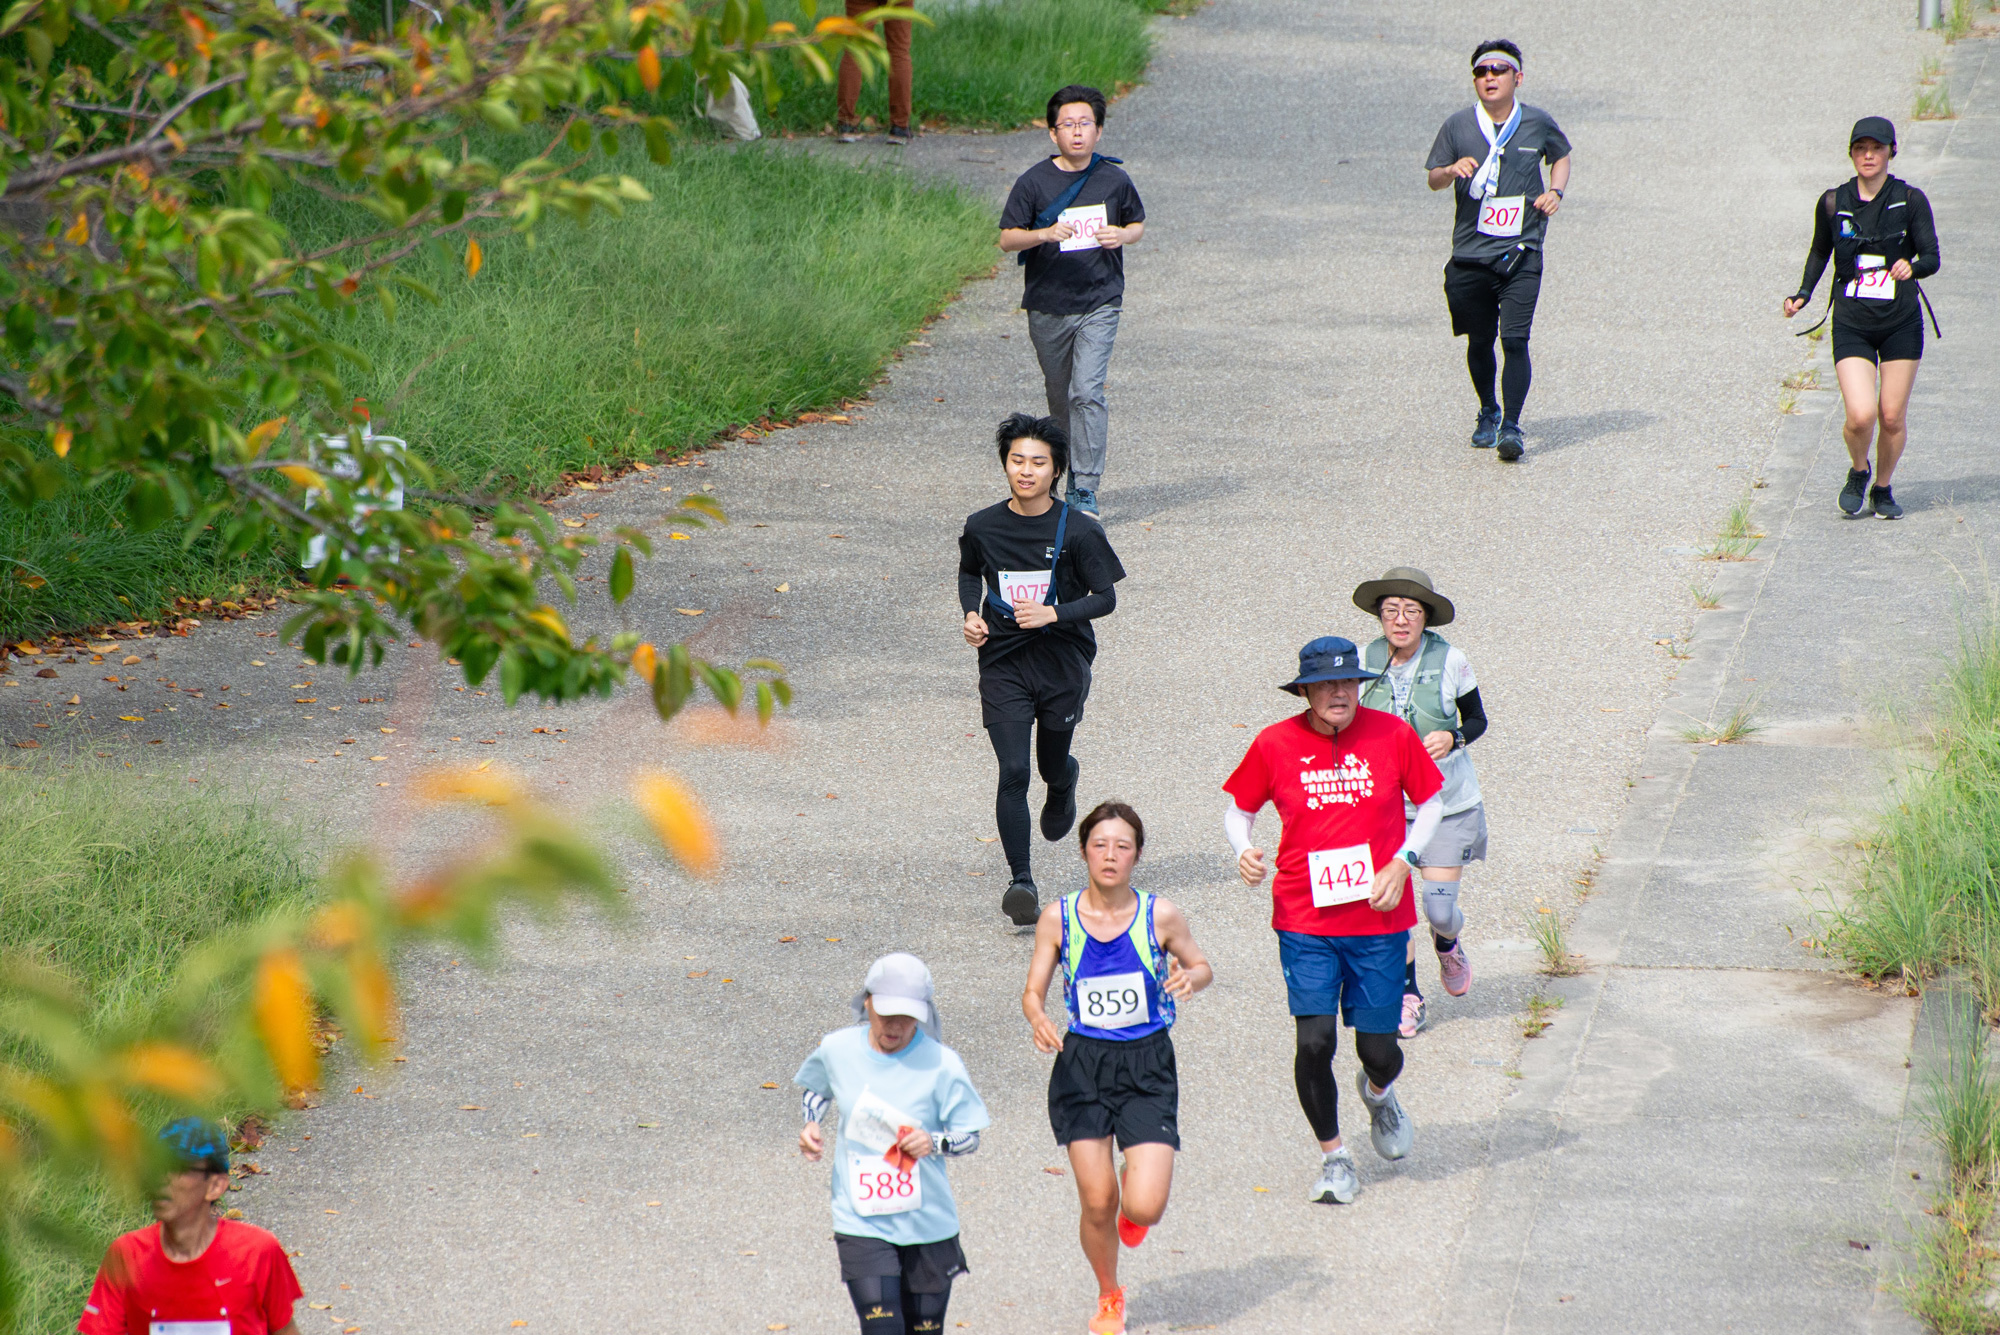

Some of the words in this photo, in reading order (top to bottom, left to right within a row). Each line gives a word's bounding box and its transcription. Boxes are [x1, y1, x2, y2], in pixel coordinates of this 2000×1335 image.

[1066, 216, 1103, 240] 067
[1483, 206, 1520, 227] 207
[1320, 793, 1354, 804] 2024
[1318, 860, 1369, 891] 442
[1087, 988, 1139, 1017] 859
[858, 1171, 914, 1201] 588
